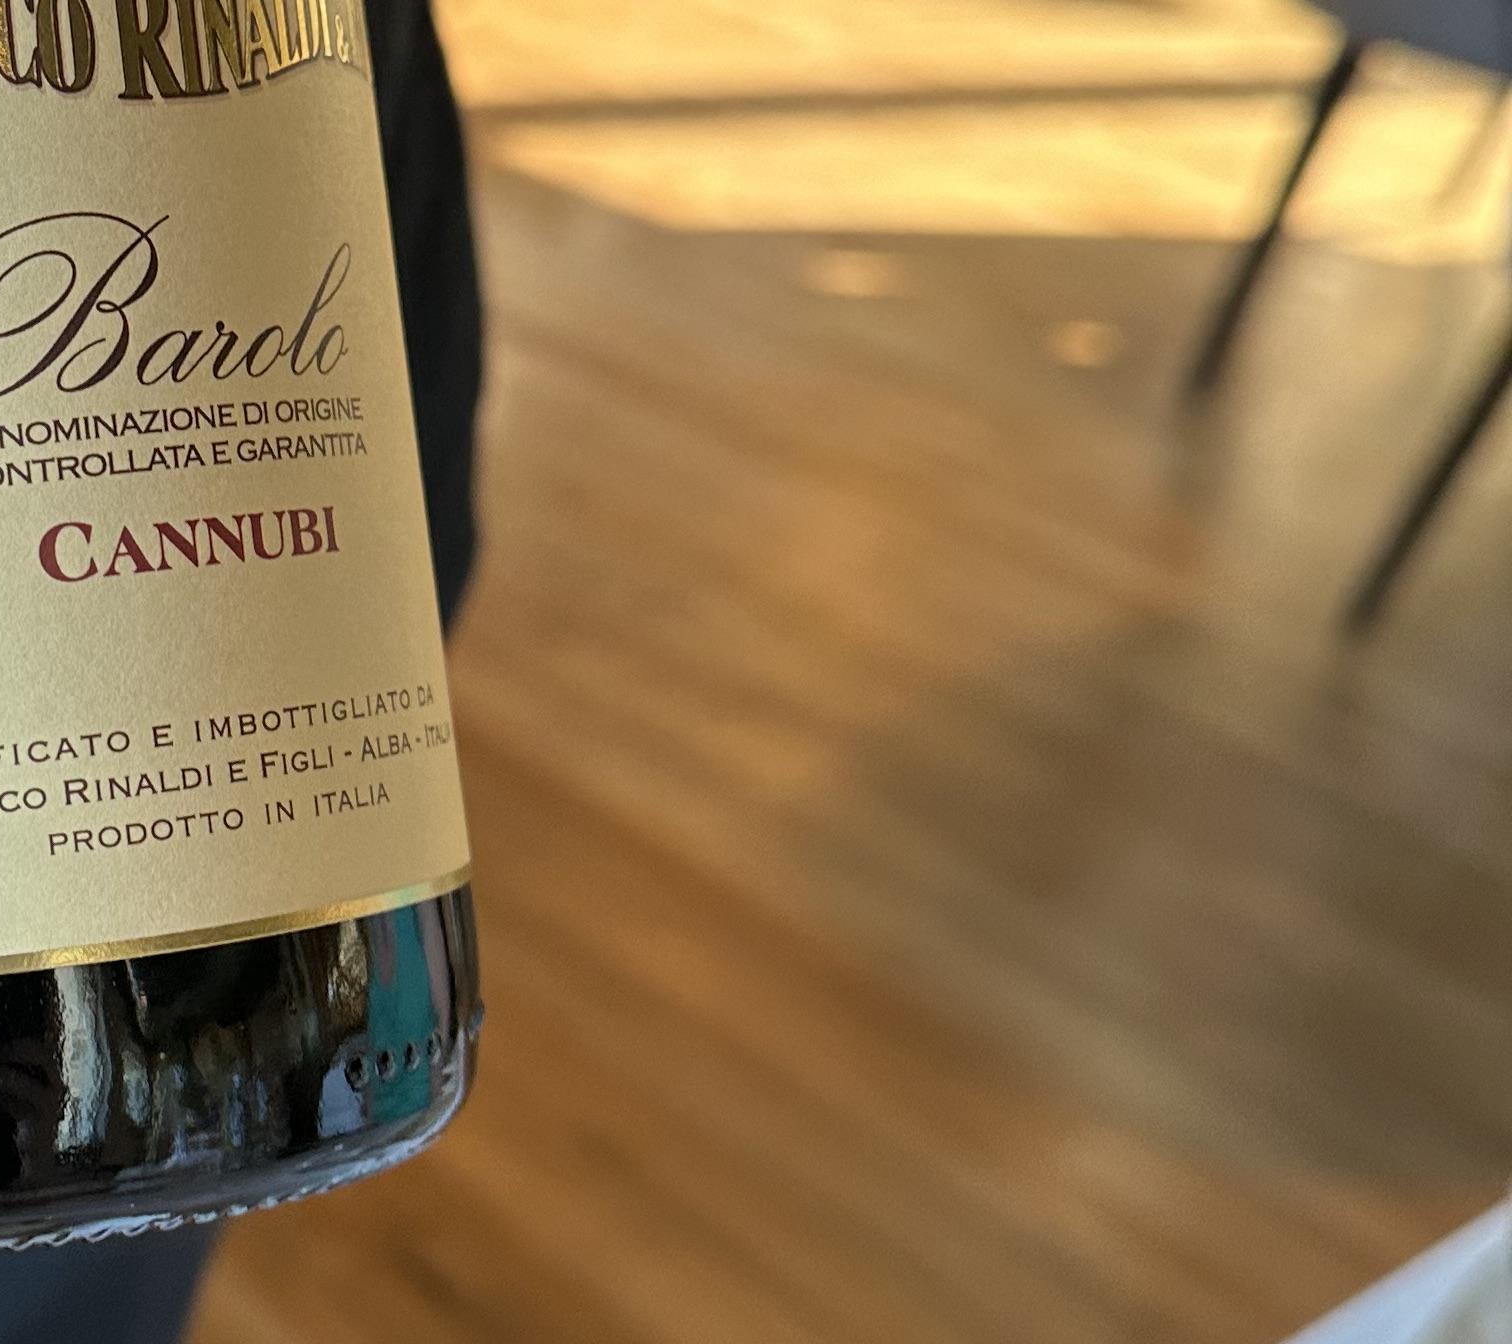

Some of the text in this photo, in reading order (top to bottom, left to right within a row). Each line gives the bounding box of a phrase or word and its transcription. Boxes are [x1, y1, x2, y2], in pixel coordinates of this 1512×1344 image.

[243, 401, 269, 426] DI
[275, 396, 364, 423] ORIGINE
[212, 441, 233, 465] E
[237, 431, 368, 462] GARANTITA
[38, 505, 340, 583] CANNUBI
[151, 723, 175, 748] E
[194, 688, 412, 743] IMBOTTIGLIATO
[416, 682, 435, 707] DA
[63, 764, 213, 806] RINALDI
[228, 759, 249, 784] E
[260, 746, 335, 778] FIGLI
[360, 732, 413, 762] ALBA
[48, 782, 391, 856] PRODOTTO IN ITALIA
